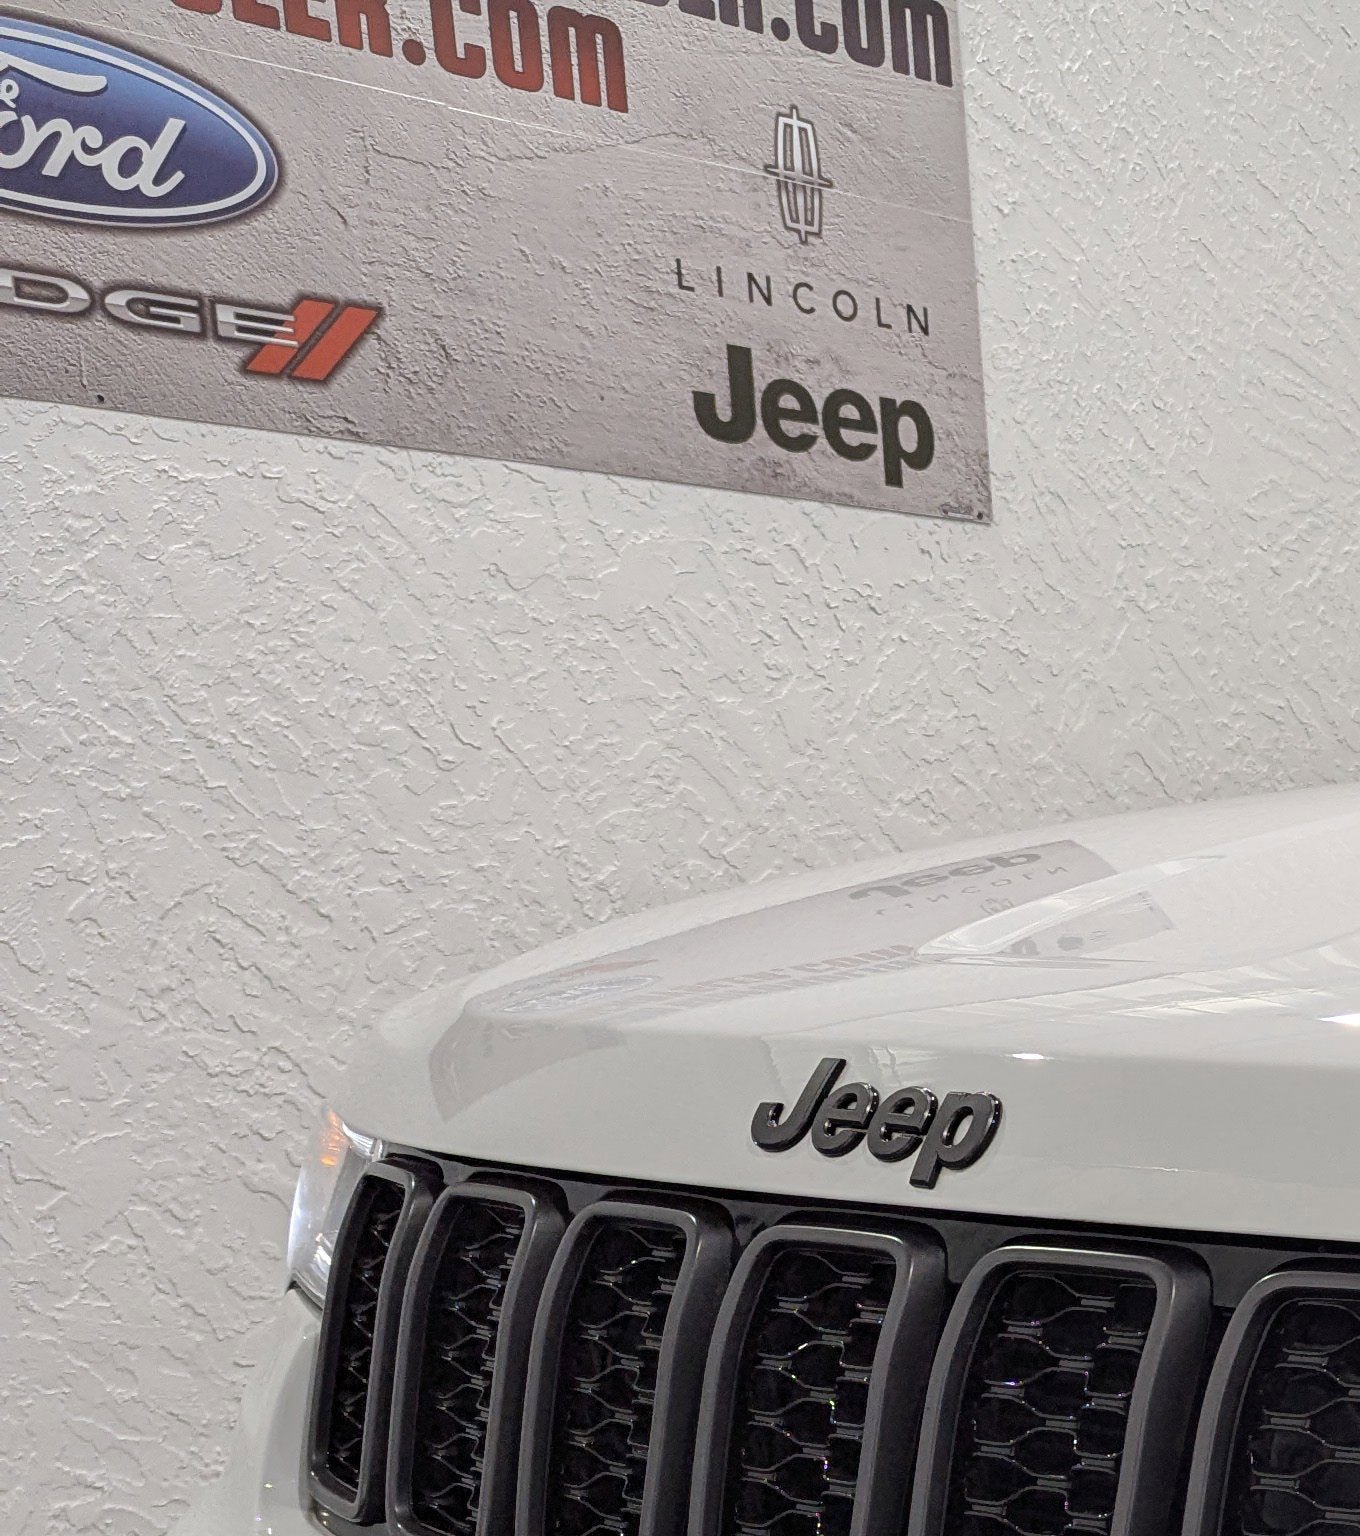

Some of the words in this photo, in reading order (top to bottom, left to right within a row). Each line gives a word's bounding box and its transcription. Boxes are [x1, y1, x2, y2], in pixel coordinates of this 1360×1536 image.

[675, 257, 930, 336] LINCOLN
[692, 343, 935, 489] Jeep
[751, 1057, 1003, 1190] Jeep
